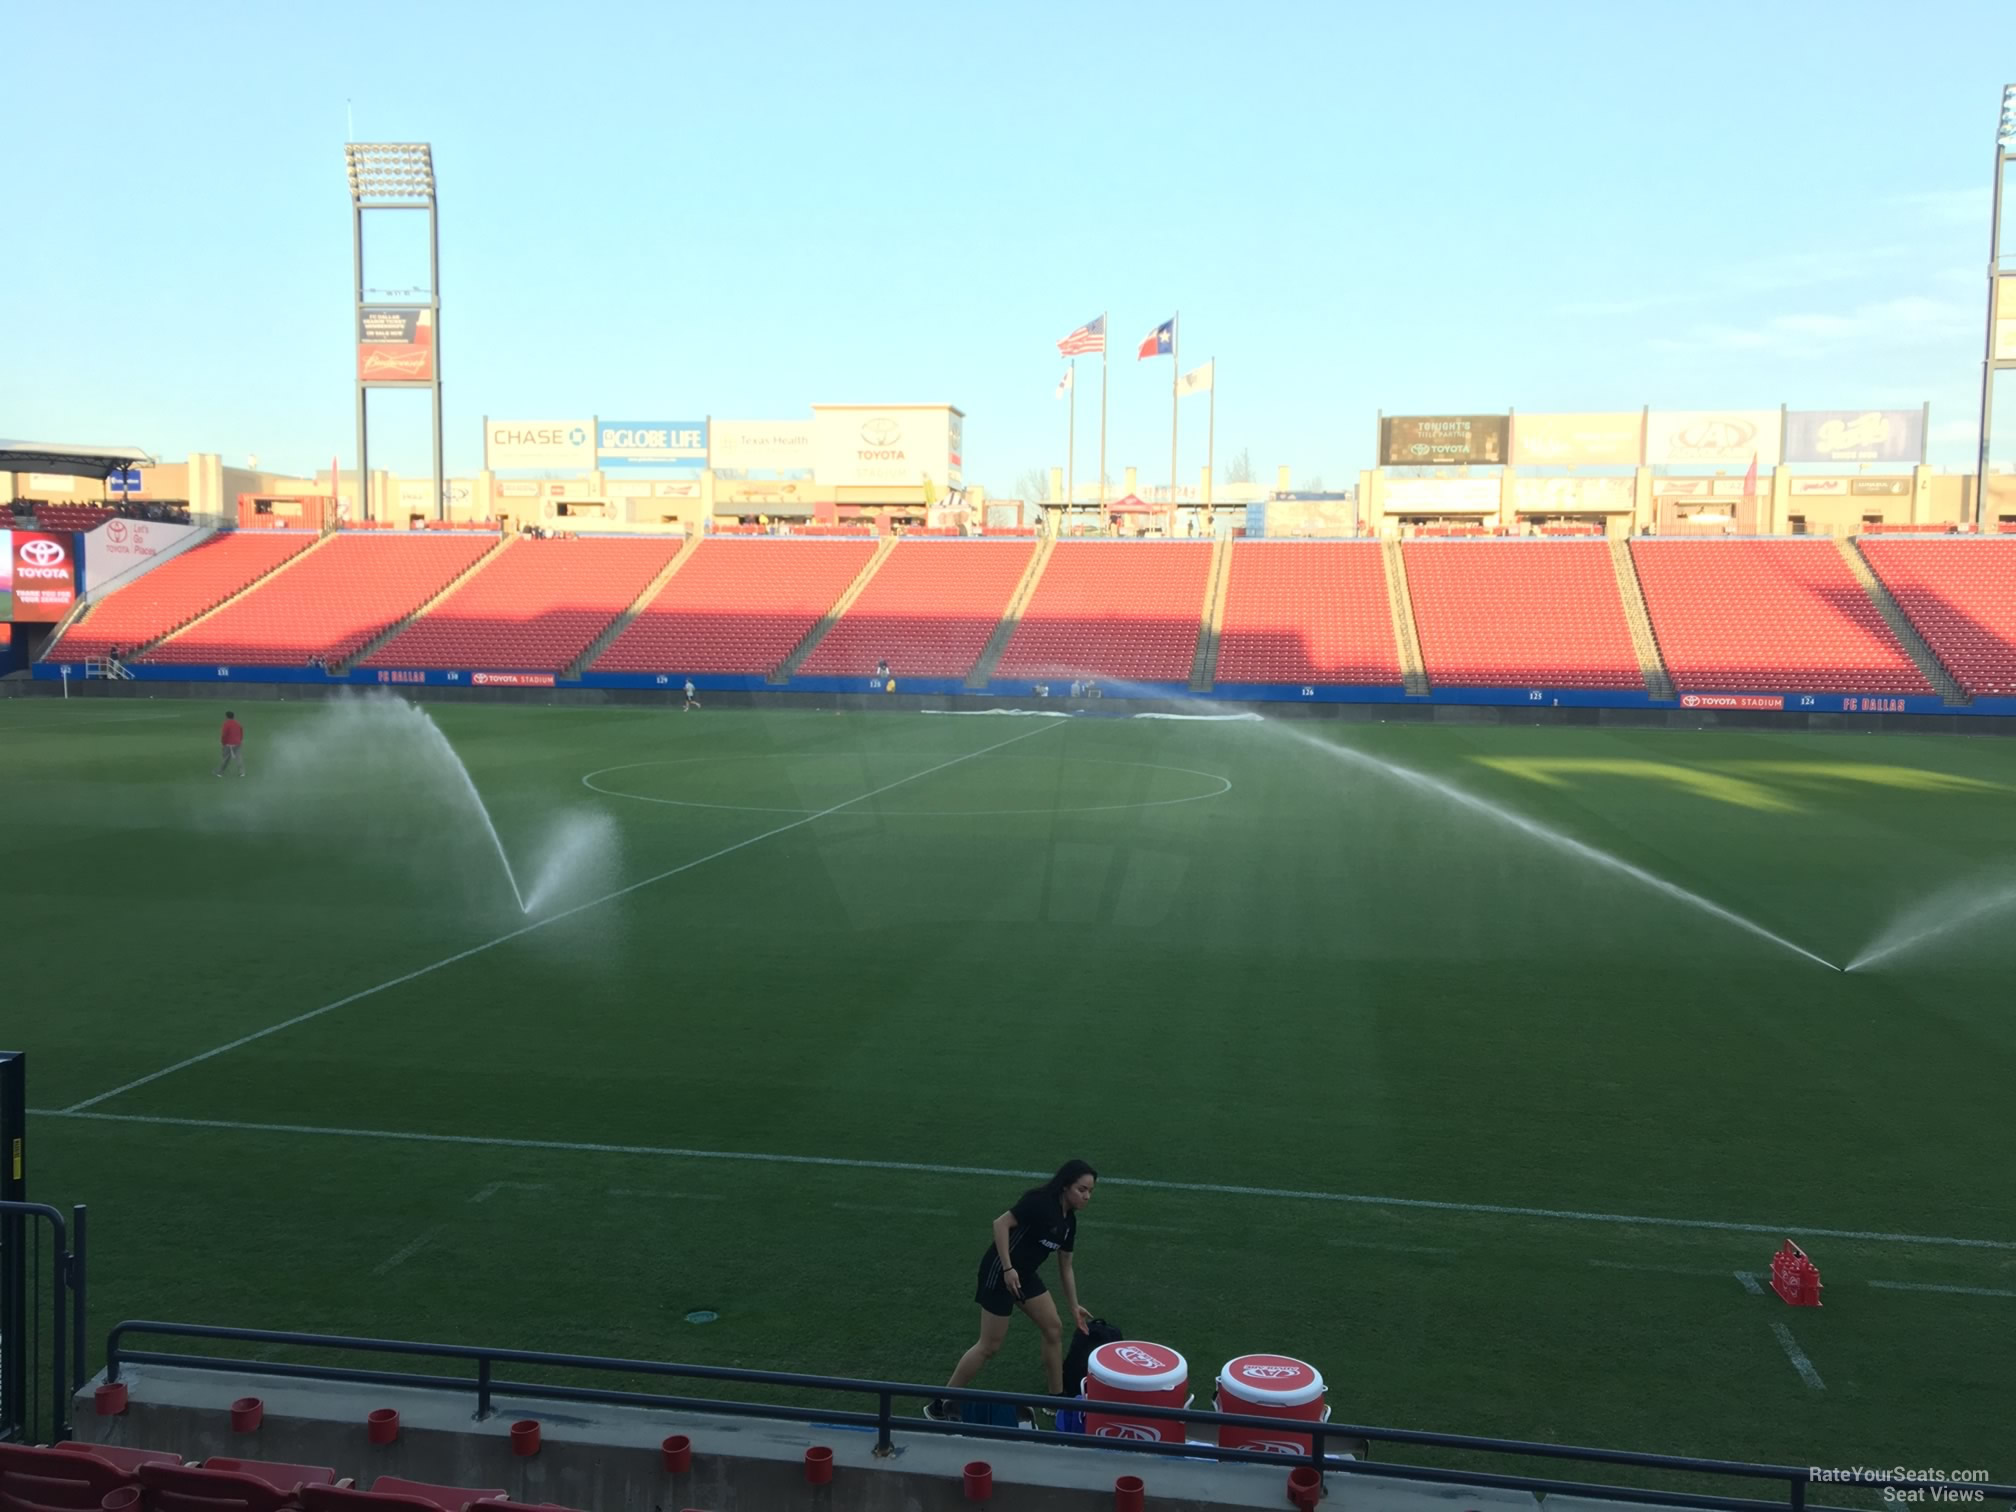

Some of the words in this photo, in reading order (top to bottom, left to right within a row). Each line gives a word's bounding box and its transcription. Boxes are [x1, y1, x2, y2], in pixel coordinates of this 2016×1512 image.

[1418, 421, 1471, 431] TONIGHT'S
[494, 429, 564, 445] CHASE
[615, 429, 667, 448] GLOBE
[671, 430, 701, 448] LIFE
[741, 434, 769, 445] Texas
[773, 434, 808, 445] Health
[1431, 444, 1471, 454] TOYOTA
[856, 450, 905, 460] TOYOTA
[16, 567, 70, 579] TOYOTA
[489, 674, 518, 683] TOYOTA
[520, 676, 554, 685] STADIUM
[1302, 688, 1315, 696] 126
[1529, 692, 1543, 700] 125
[1701, 697, 1737, 706] TOYOTA
[1741, 698, 1782, 708] STADIUM
[1800, 697, 1815, 706] 124
[1843, 698, 1857, 711] FC
[1861, 698, 1905, 712] DALLAS
